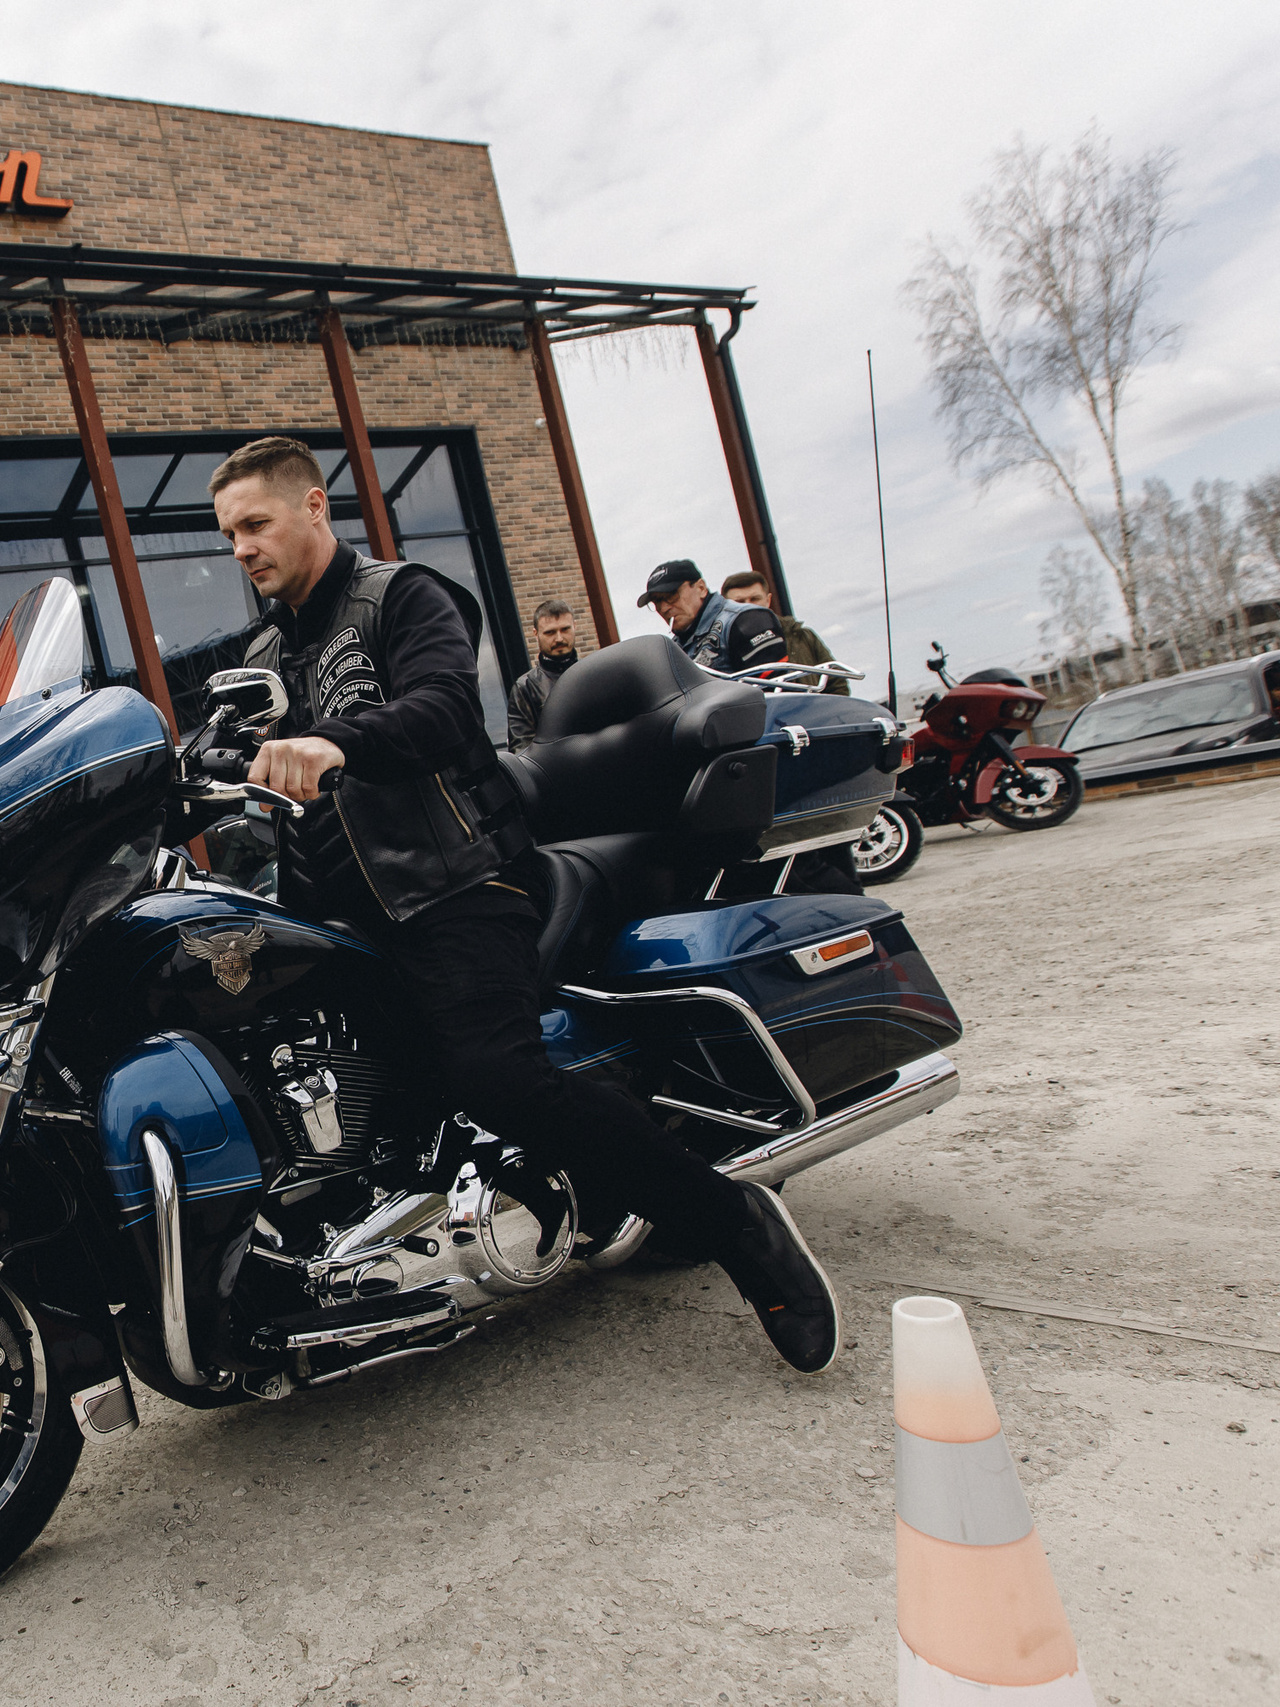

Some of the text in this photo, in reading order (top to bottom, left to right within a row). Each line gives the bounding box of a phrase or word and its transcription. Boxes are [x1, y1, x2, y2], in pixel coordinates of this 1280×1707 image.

[321, 630, 354, 666] DIRECTOR
[321, 655, 363, 694] LIFE MEMBER
[325, 683, 375, 718] BAIKAL CHAPTER
[336, 691, 360, 710] RUSSIA
